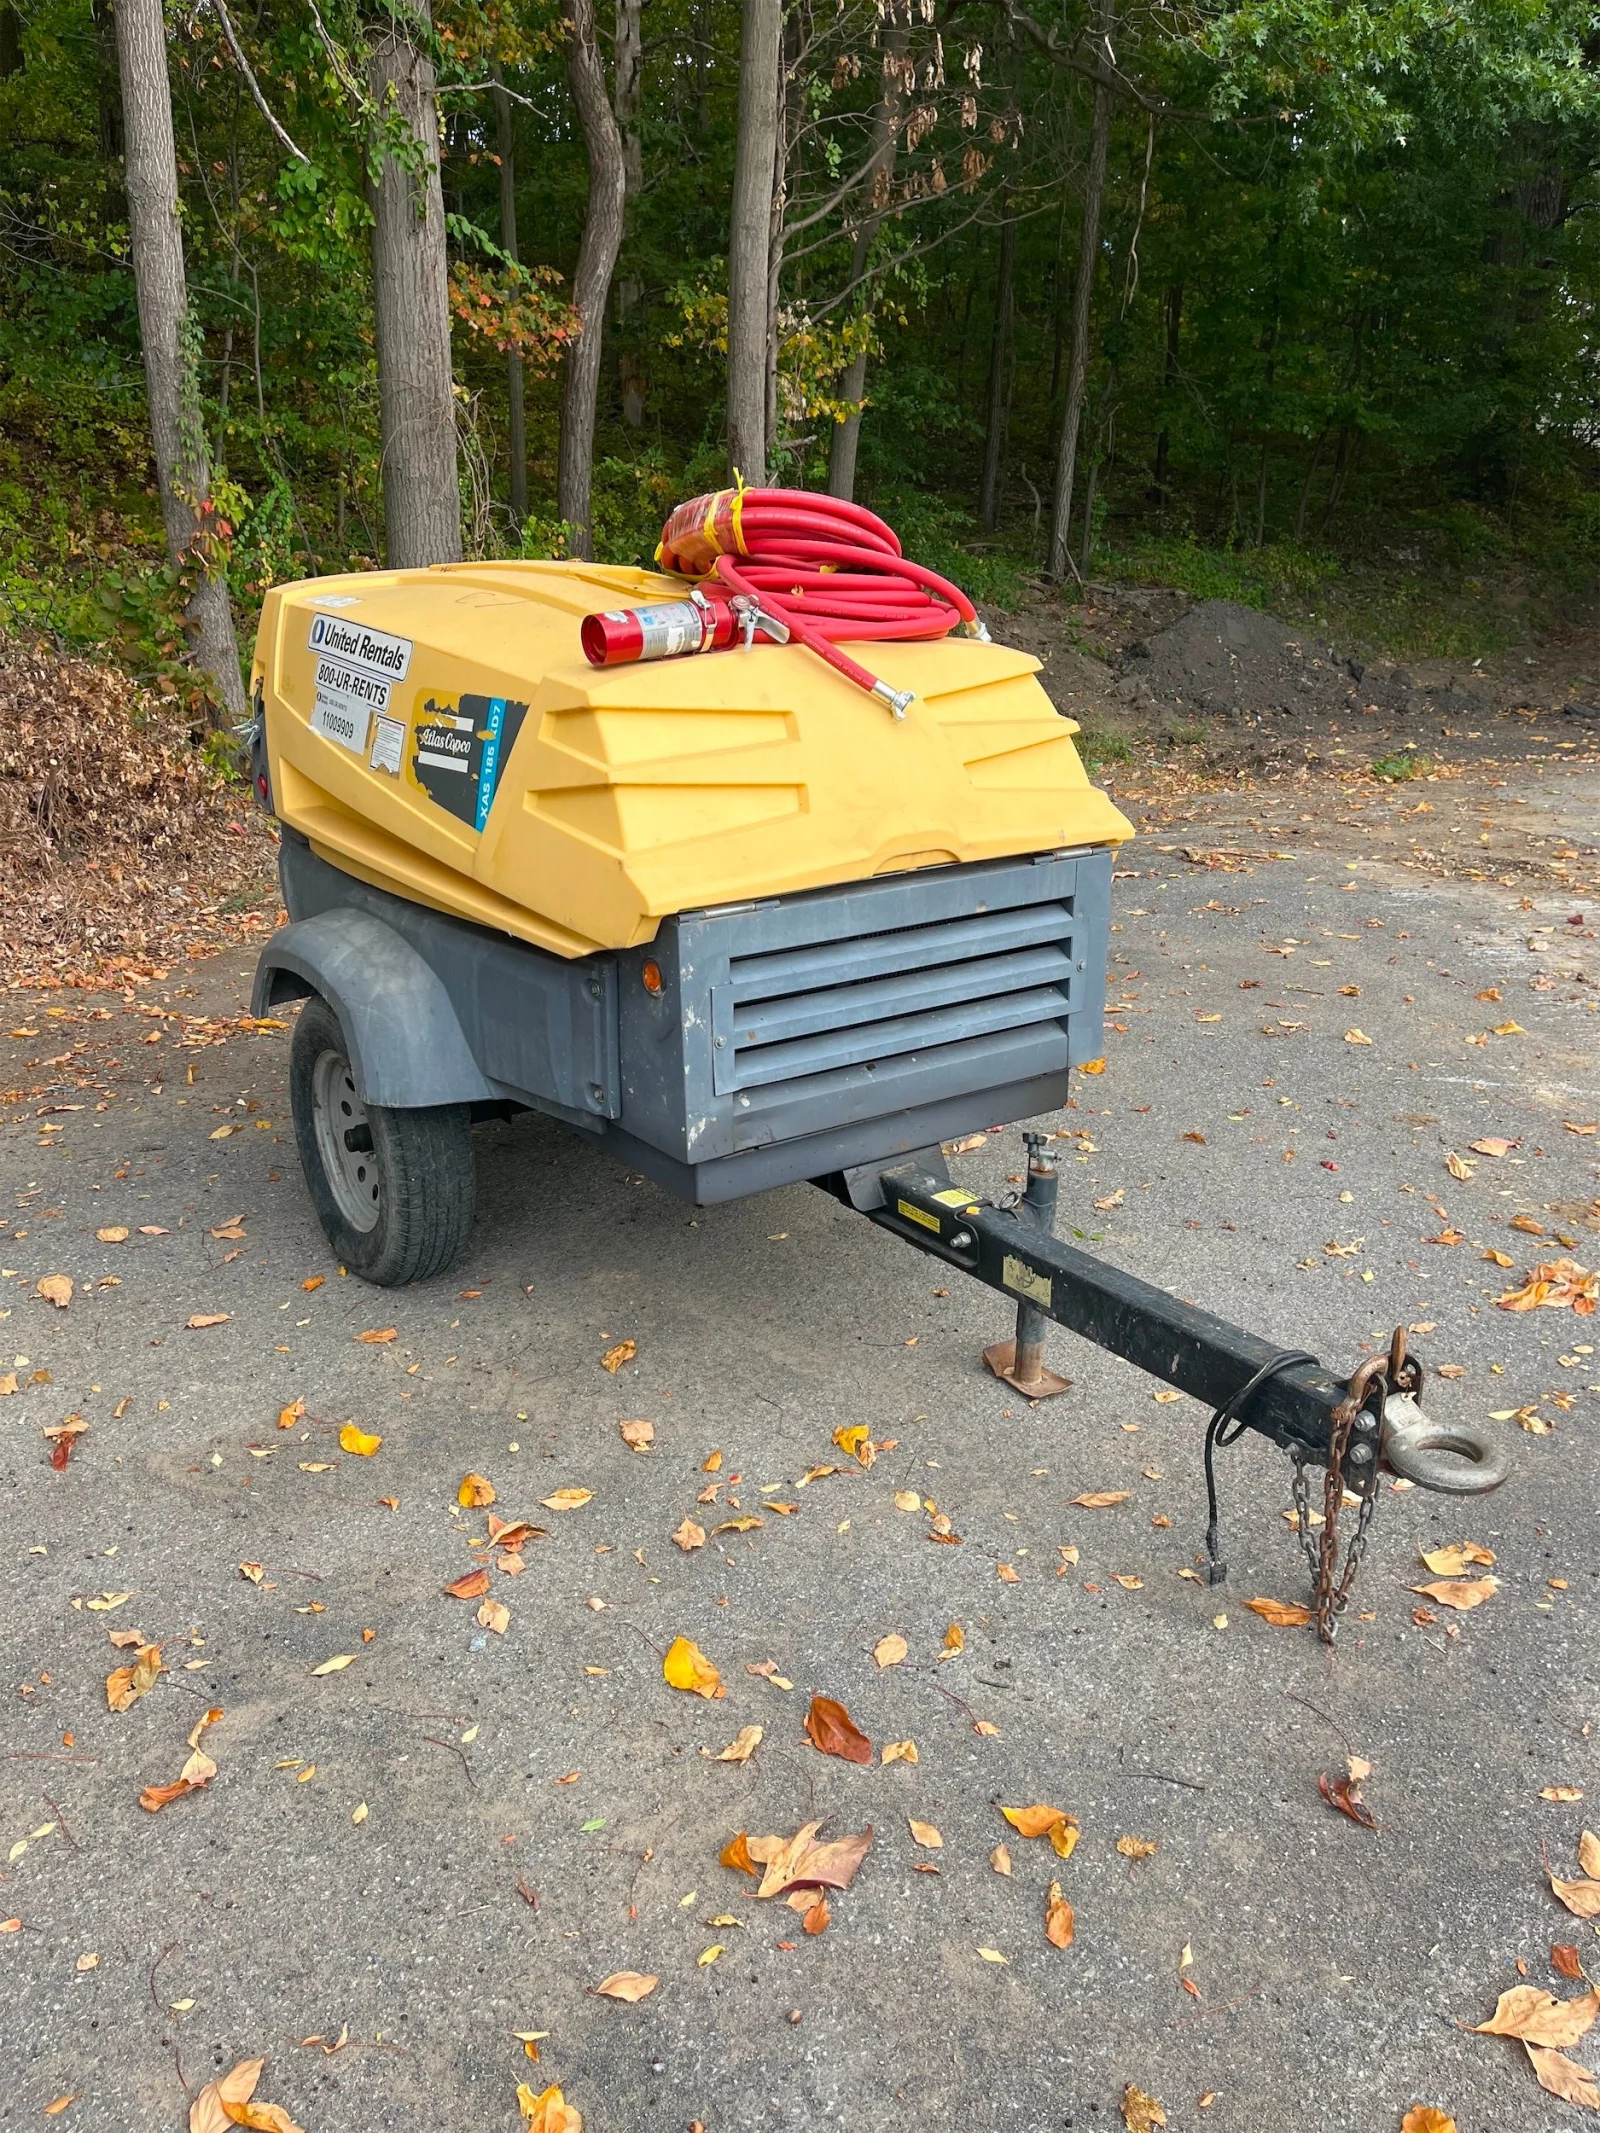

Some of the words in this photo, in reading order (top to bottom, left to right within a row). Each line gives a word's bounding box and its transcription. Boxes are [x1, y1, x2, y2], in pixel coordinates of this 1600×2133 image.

[325, 623, 361, 655] United
[359, 635, 404, 671] Rentals
[318, 664, 387, 705] 800-UR-RENTS
[420, 728, 445, 749] Atlas
[485, 746, 495, 775] 185
[480, 782, 491, 819] XAS
